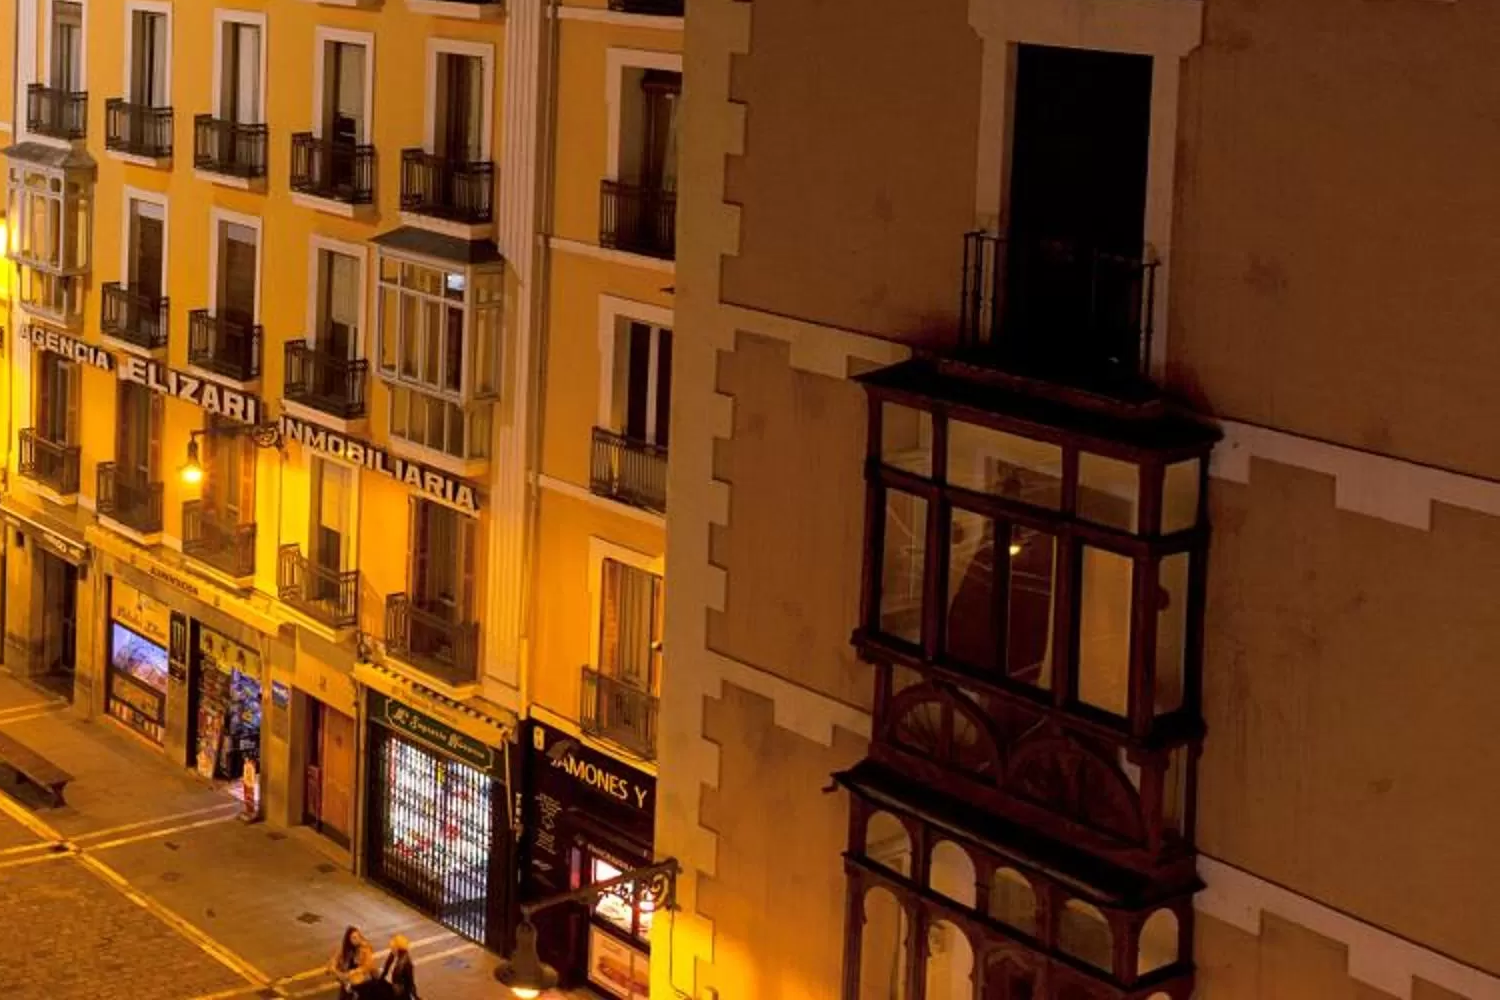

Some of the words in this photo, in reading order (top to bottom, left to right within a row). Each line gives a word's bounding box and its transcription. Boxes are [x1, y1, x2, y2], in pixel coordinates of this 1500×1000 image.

[19, 326, 109, 370] AGENCIA
[124, 357, 256, 425] ELIZARI
[279, 416, 476, 512] INMOBILIARIA
[634, 785, 648, 808] Y
